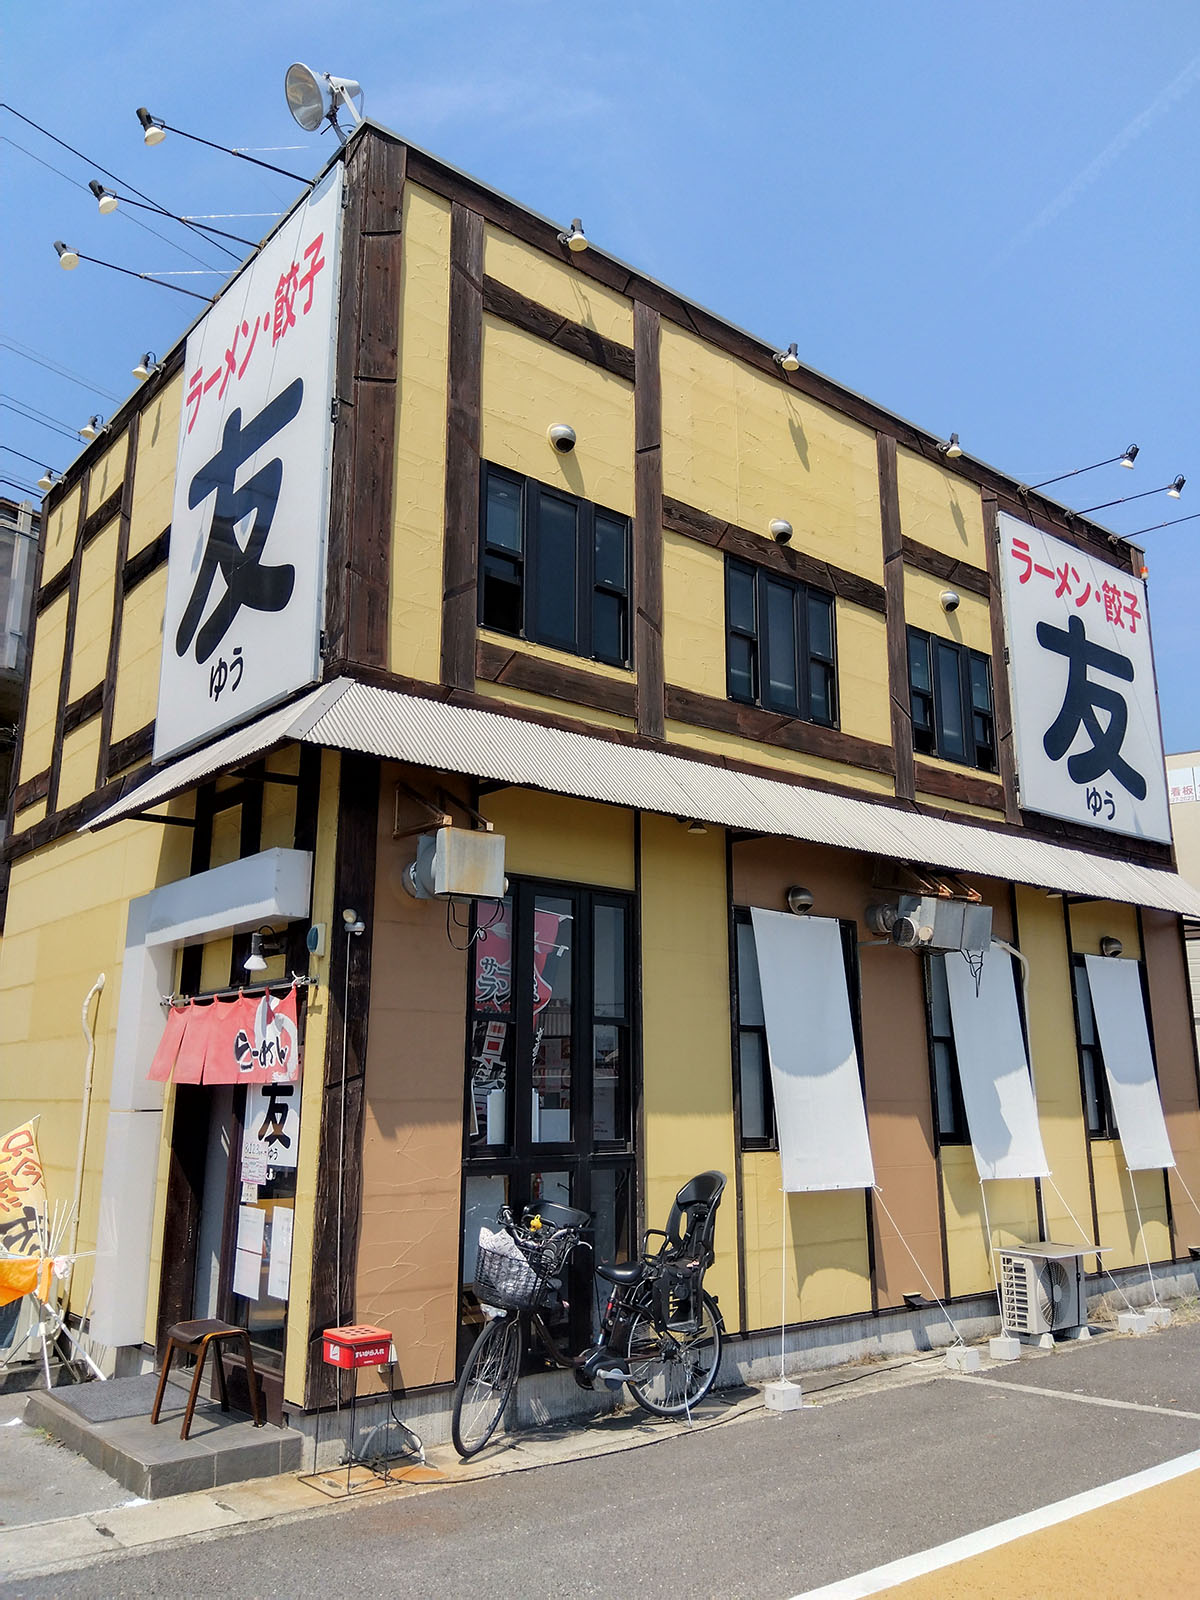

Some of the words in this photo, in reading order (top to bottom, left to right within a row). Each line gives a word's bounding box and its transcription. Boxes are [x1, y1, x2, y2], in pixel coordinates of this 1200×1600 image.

[186, 231, 325, 435] ラーメン・餃子
[175, 376, 304, 665] 友
[1011, 537, 1142, 634] ラーメン・餃子
[209, 646, 244, 702] ゆう
[1036, 614, 1147, 801] 友
[1086, 786, 1116, 820] ゆう
[234, 1030, 288, 1070] らーめん
[258, 1083, 294, 1149] 友
